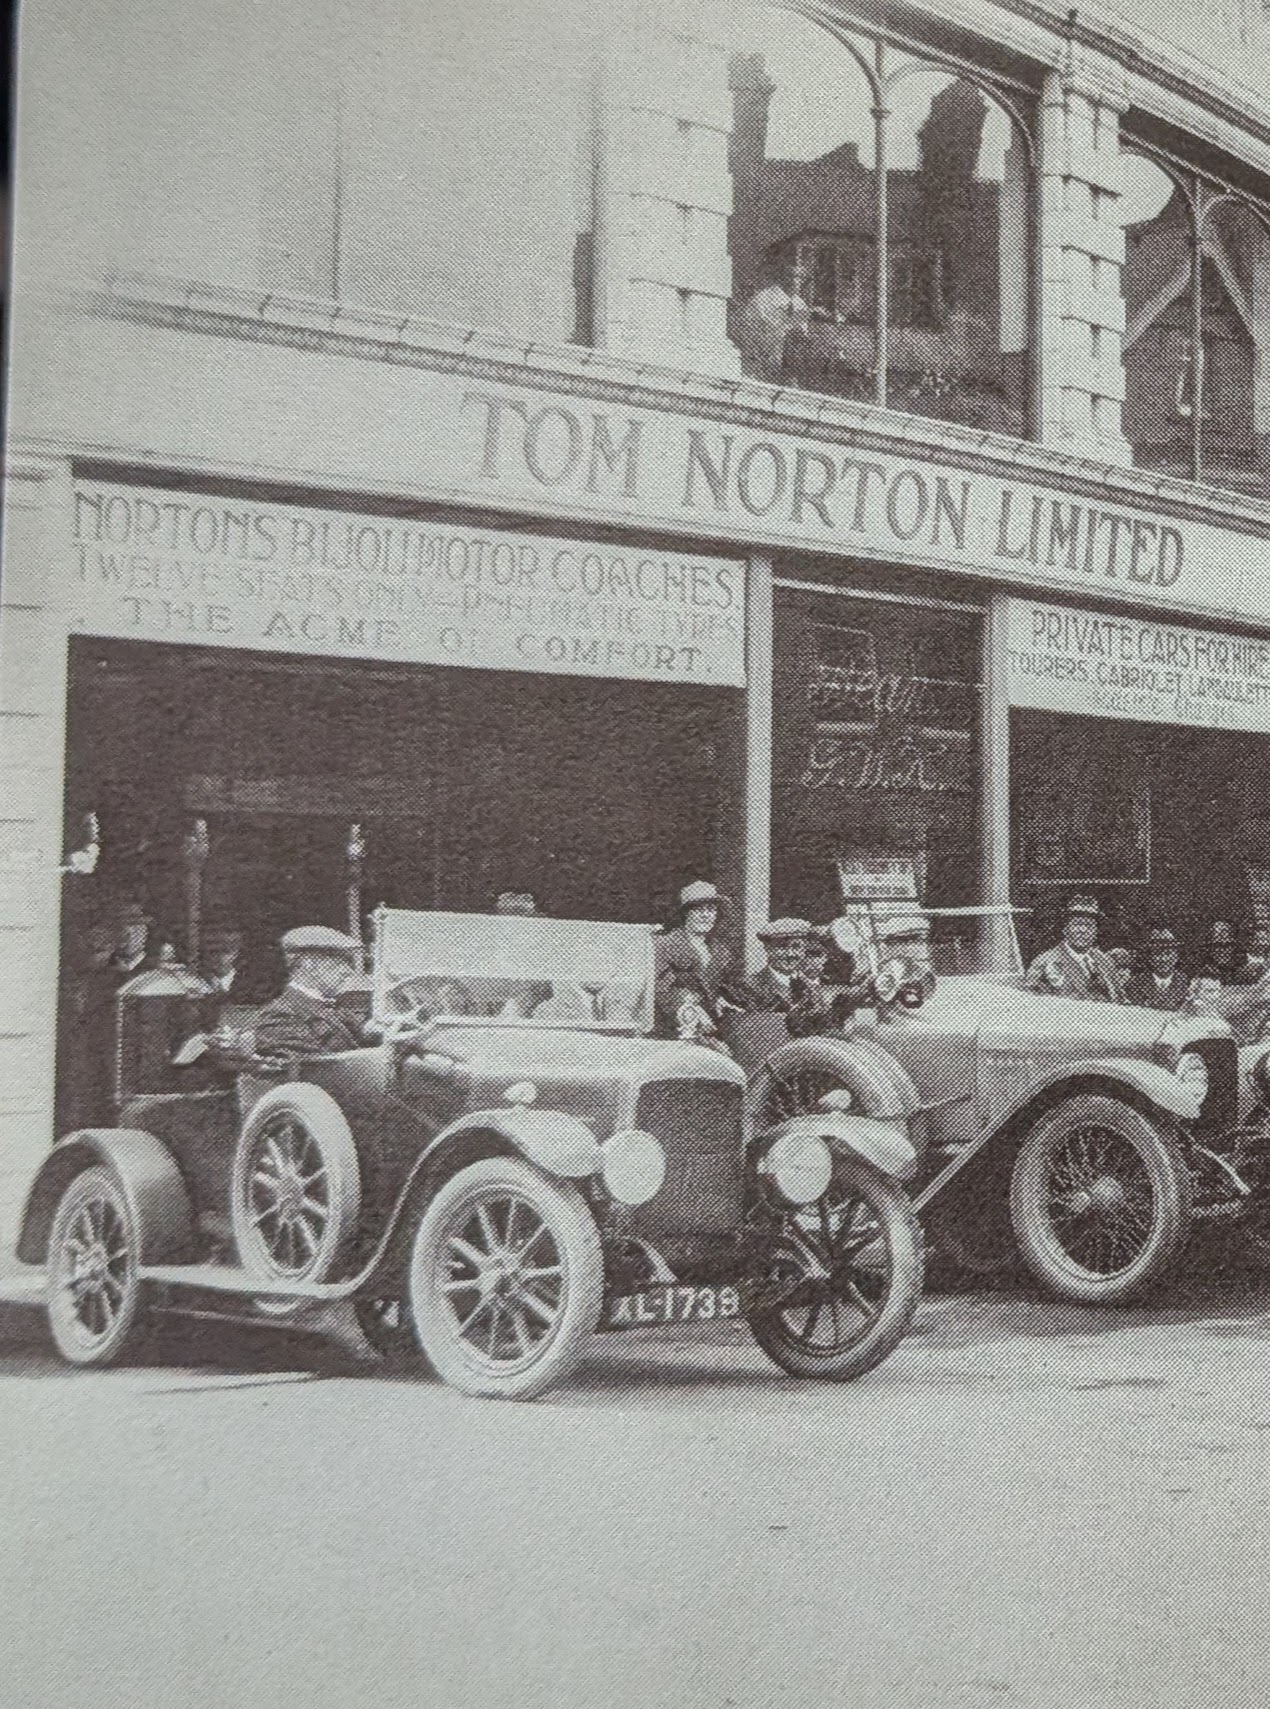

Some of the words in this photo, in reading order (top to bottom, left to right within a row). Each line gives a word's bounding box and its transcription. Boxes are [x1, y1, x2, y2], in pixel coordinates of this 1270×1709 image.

[462, 391, 642, 500] TOM
[681, 428, 971, 551] NORTON
[994, 489, 1184, 589] LIMITED
[71, 542, 222, 597] TWELVE
[291, 517, 409, 575] BIJOU
[416, 532, 540, 587] MOTOR
[121, 595, 233, 635] THE
[262, 610, 402, 648] ACME
[1031, 608, 1134, 661] PRIVATE
[1137, 627, 1191, 669] CARS
[1194, 635, 1230, 674] FOR
